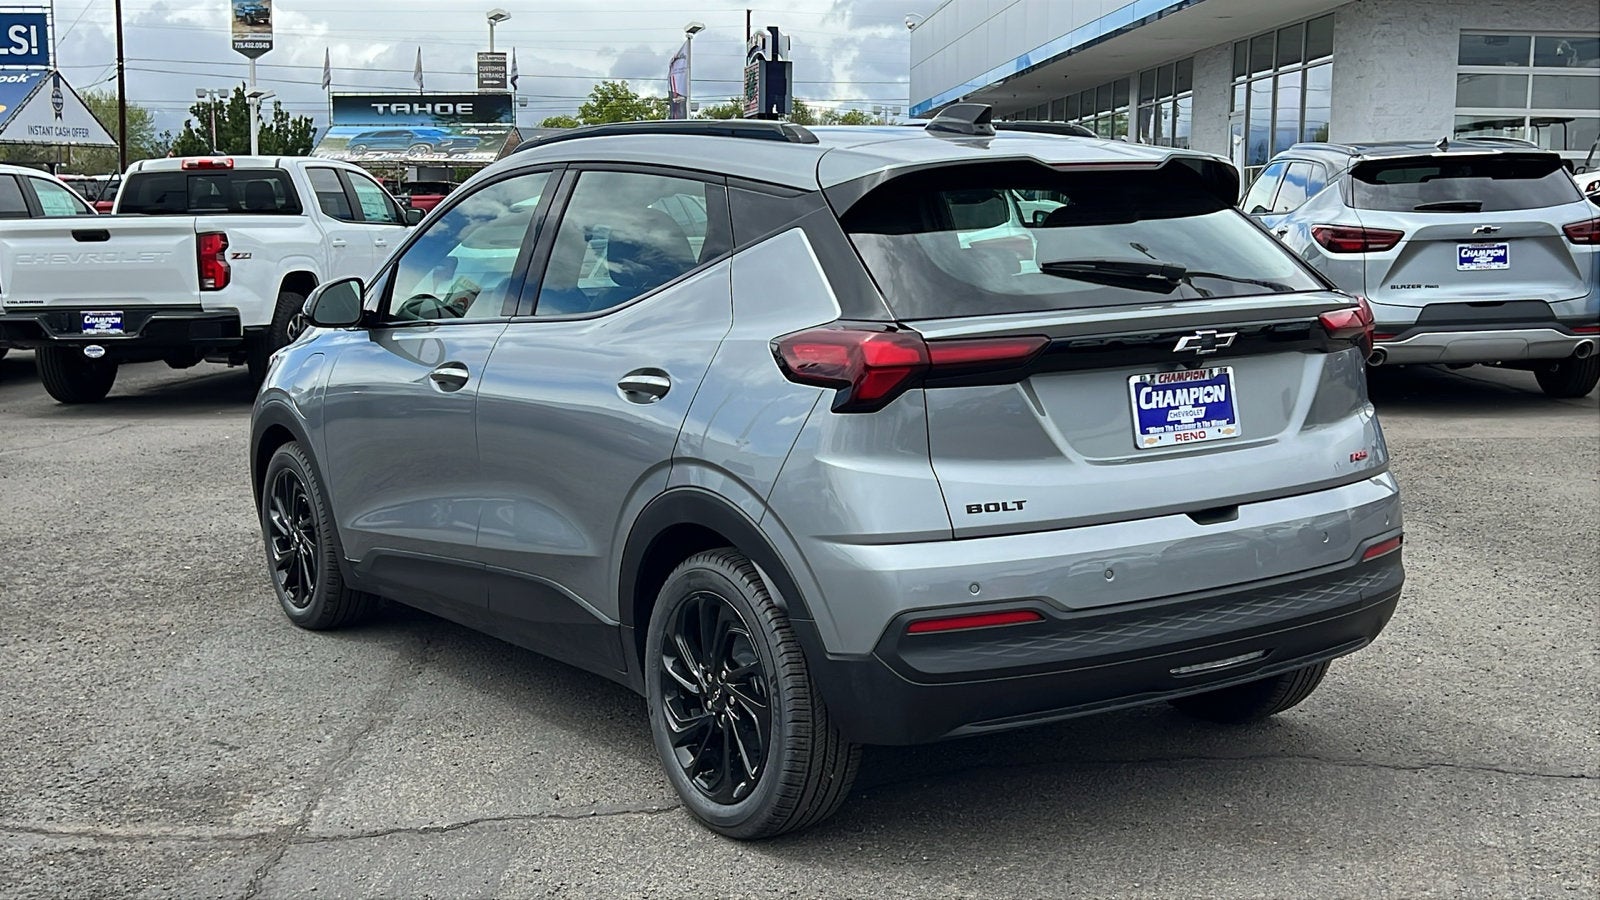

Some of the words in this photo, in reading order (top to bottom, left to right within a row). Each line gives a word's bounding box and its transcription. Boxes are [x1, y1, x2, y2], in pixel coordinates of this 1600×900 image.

[371, 103, 473, 115] TAHOE
[28, 125, 53, 136] INSTANT
[55, 126, 71, 137] CASH
[71, 127, 90, 138] OFFER
[16, 251, 172, 265] CHEVROLET
[1461, 248, 1505, 257] CHAMPION
[84, 315, 121, 323] CHAMPION
[1158, 370, 1206, 384] CHAMPION
[1139, 384, 1226, 410] CHAMPION
[1169, 408, 1203, 419] CHEVROLET
[1174, 430, 1207, 442] RENO
[1350, 451, 1368, 463] RS
[965, 500, 1027, 514] BOLT
